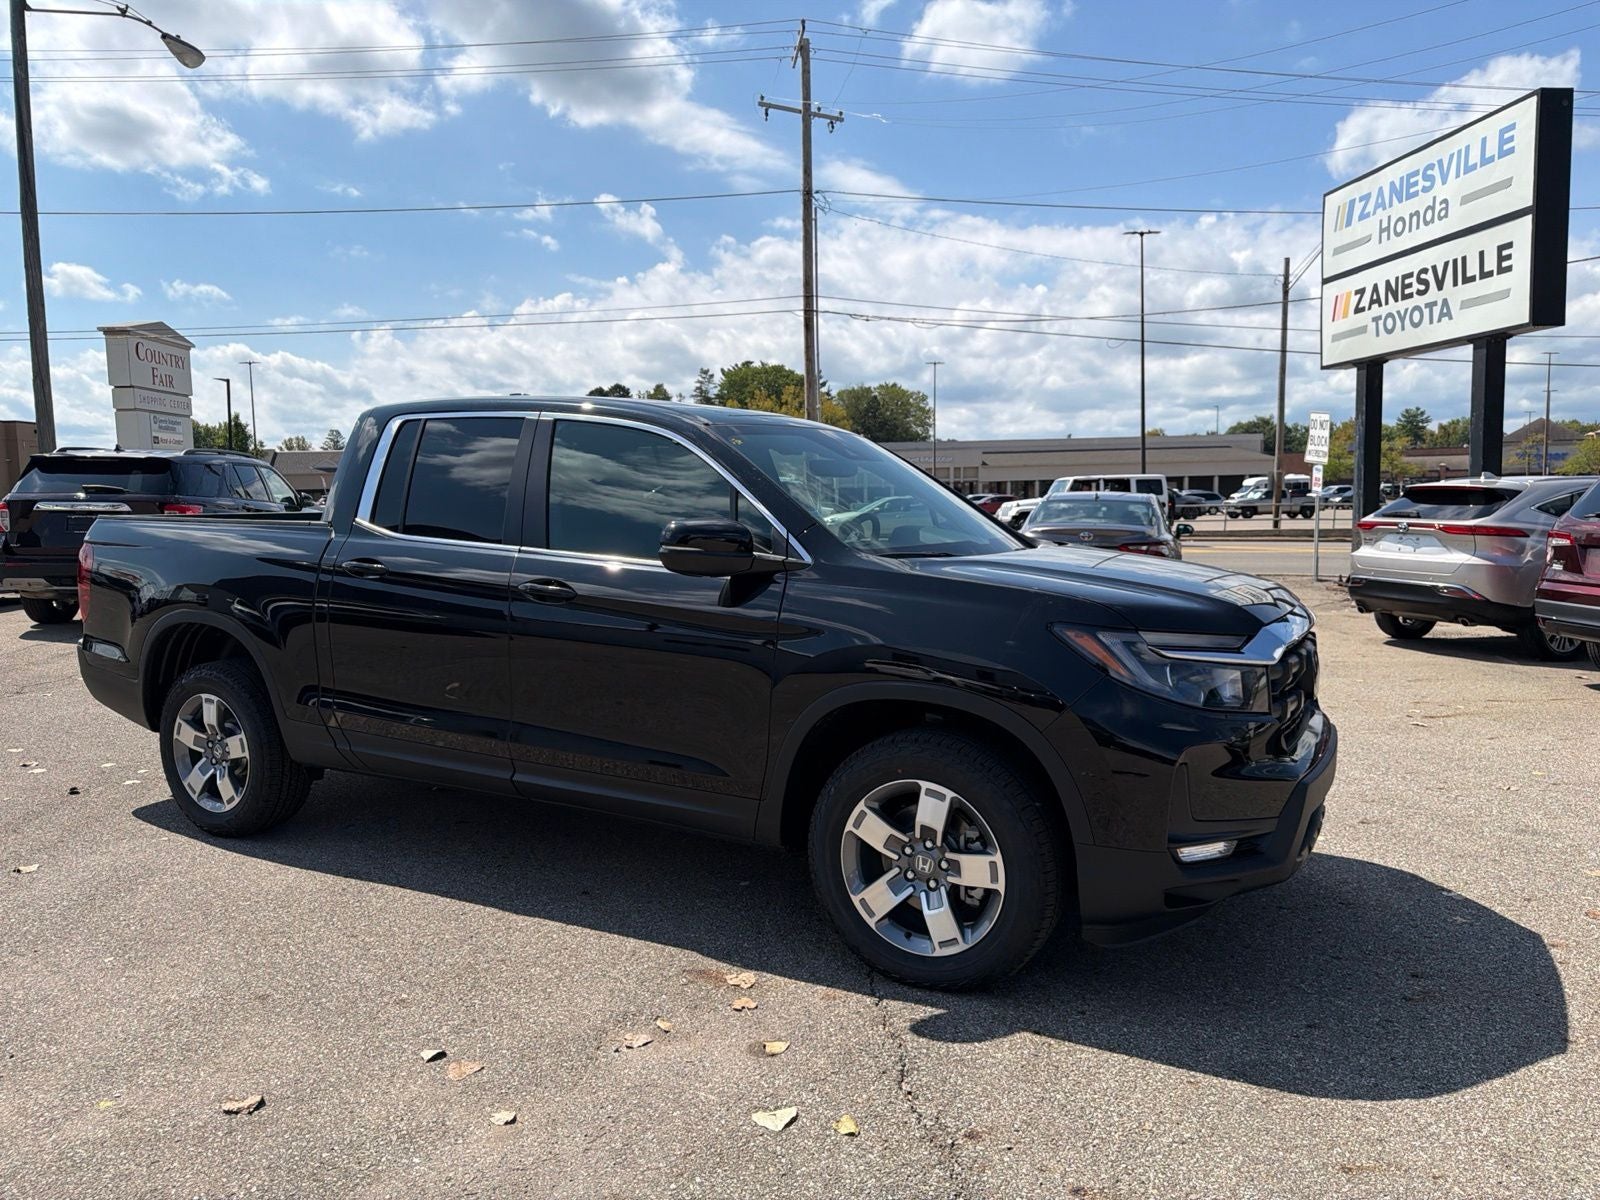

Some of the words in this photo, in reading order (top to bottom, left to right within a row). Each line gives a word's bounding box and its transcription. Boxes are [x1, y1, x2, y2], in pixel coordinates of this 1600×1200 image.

[1357, 122, 1516, 221] ZANESVILLE
[1378, 196, 1450, 245] Honda
[1354, 241, 1514, 315] ZANESVILLE
[1371, 298, 1454, 338] TOYOTA
[135, 341, 186, 370] COUNTRY
[151, 366, 175, 389] FAIR
[139, 394, 167, 408] SHOPPING
[169, 399, 191, 411] CENTER
[1310, 418, 1317, 431] DO
[1319, 419, 1329, 431] NOT
[1309, 434, 1328, 447] BLOCK
